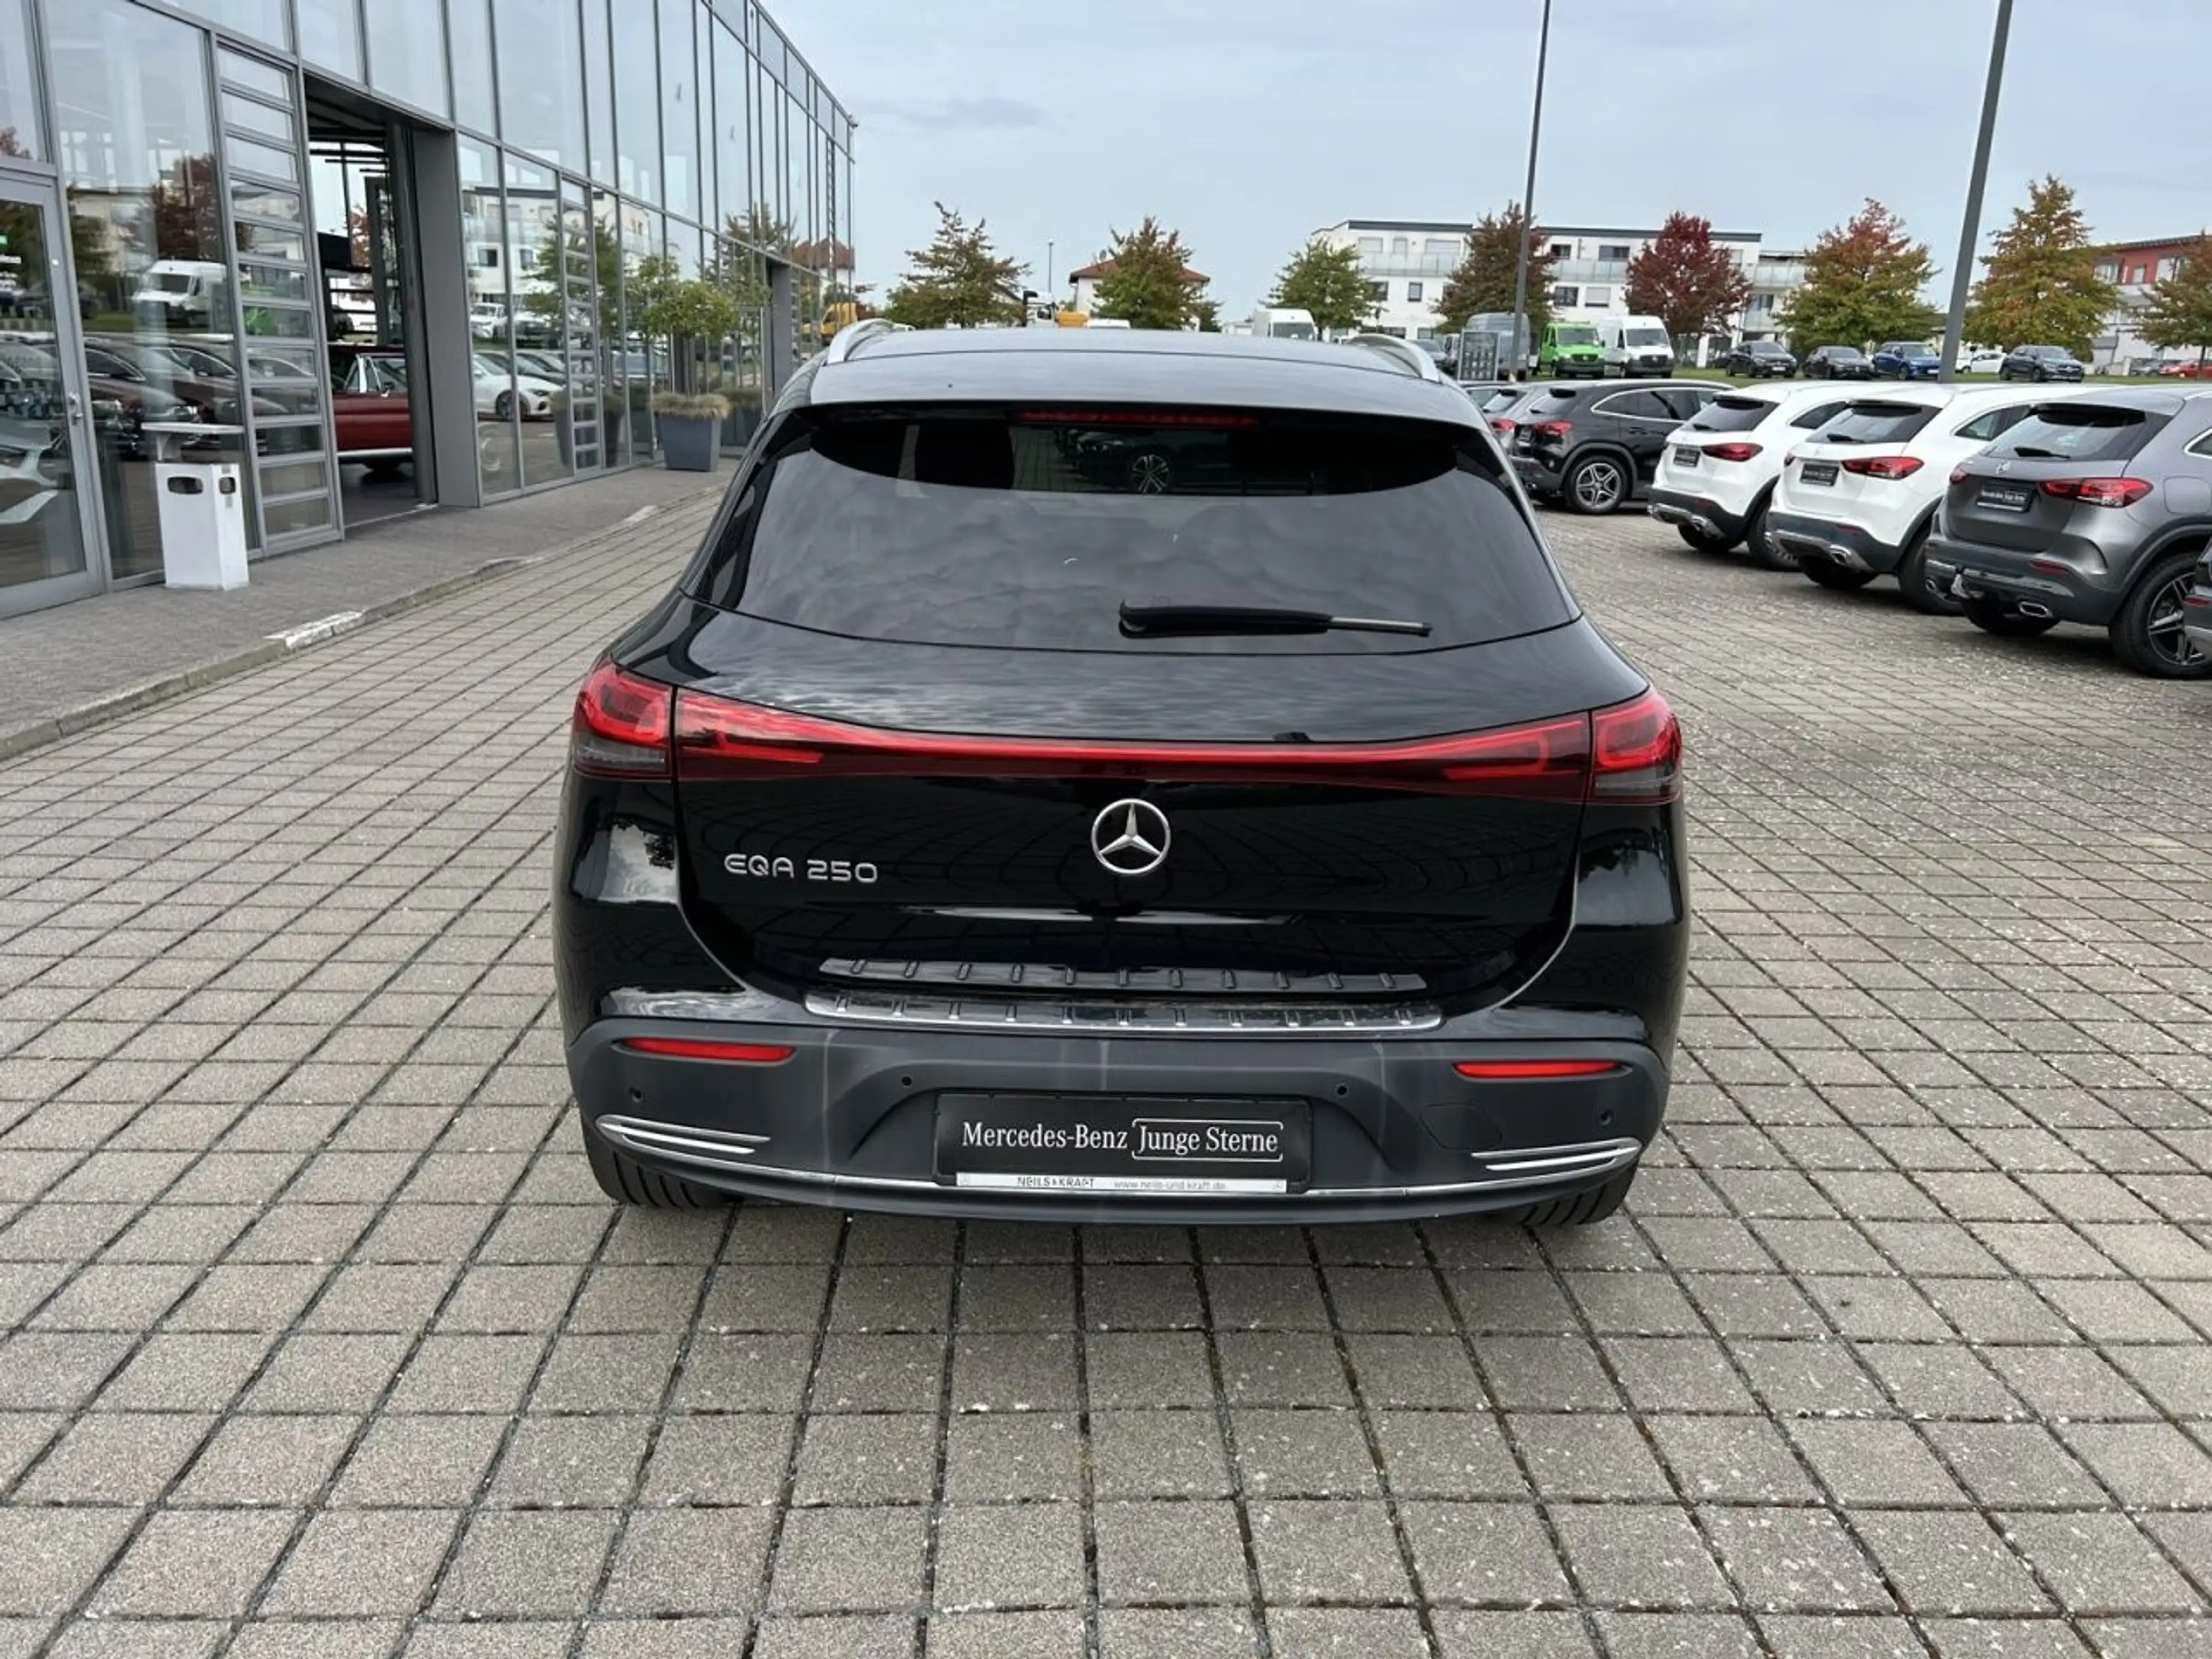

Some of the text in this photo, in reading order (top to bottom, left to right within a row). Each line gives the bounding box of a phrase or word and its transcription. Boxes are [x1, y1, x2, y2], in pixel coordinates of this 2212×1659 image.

[724, 853, 877, 883] EQA 250
[962, 1122, 1278, 1156] Mercedes-Benz Junge Sterne
